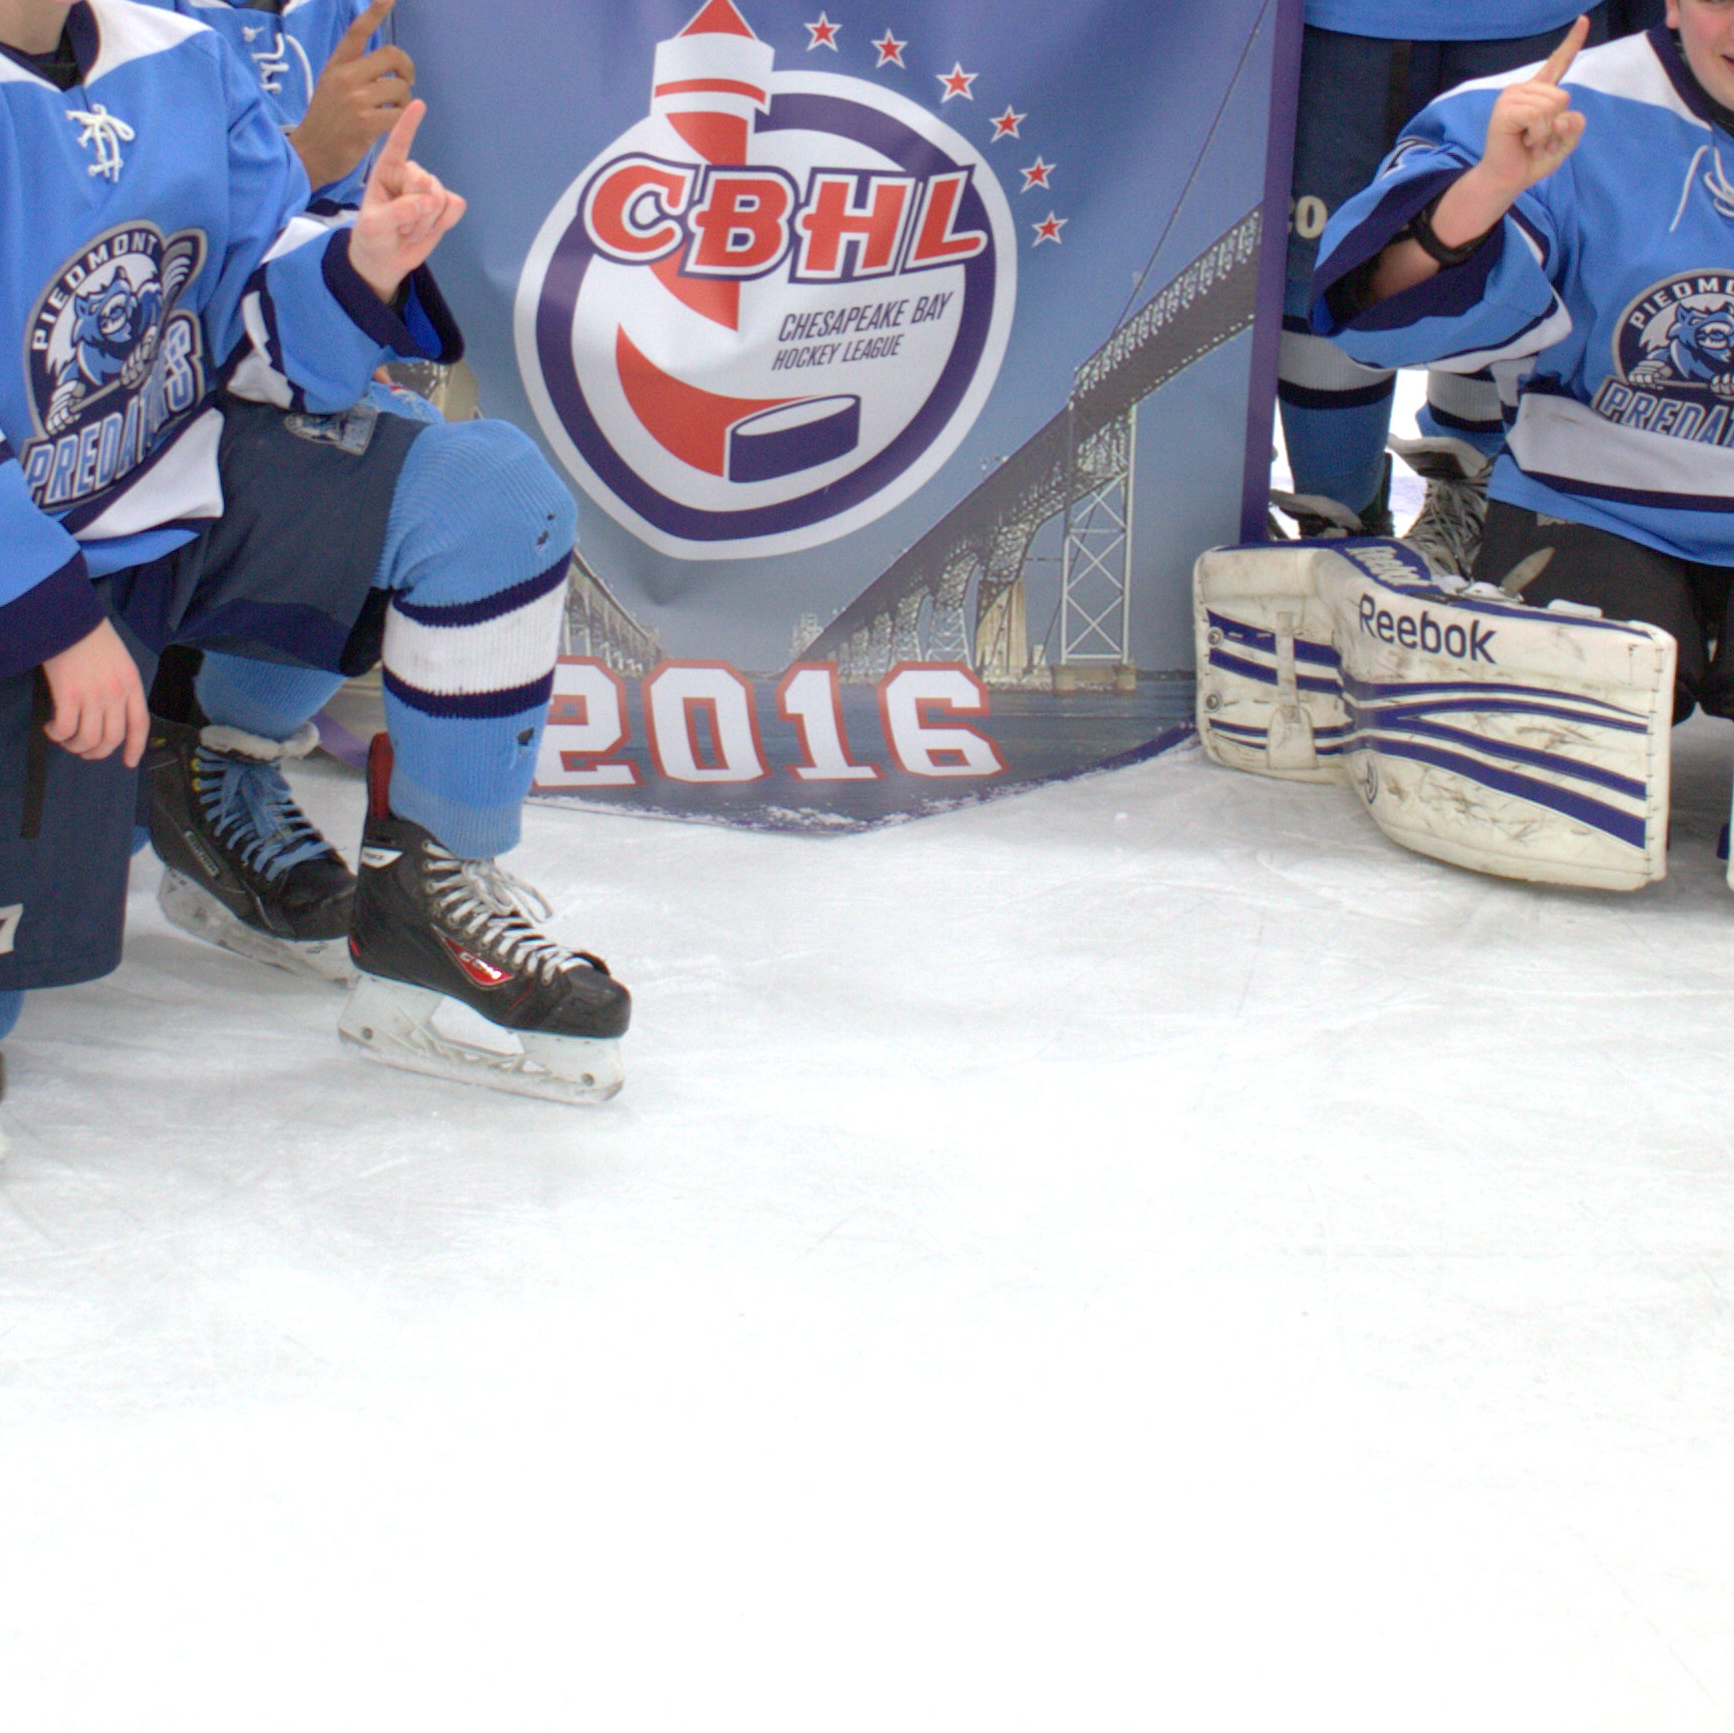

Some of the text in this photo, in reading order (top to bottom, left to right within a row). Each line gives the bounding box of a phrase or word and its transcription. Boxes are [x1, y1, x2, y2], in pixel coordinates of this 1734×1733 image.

[579, 152, 990, 287] CBHL
[1288, 194, 1329, 240] 0
[31, 231, 160, 353] PIEDMONT
[777, 290, 956, 343] CHESAPEAKE BAY
[770, 333, 906, 372] HOCKEY LEAGUE
[1359, 592, 1498, 665] Reebok
[534, 654, 1006, 791] 2016
